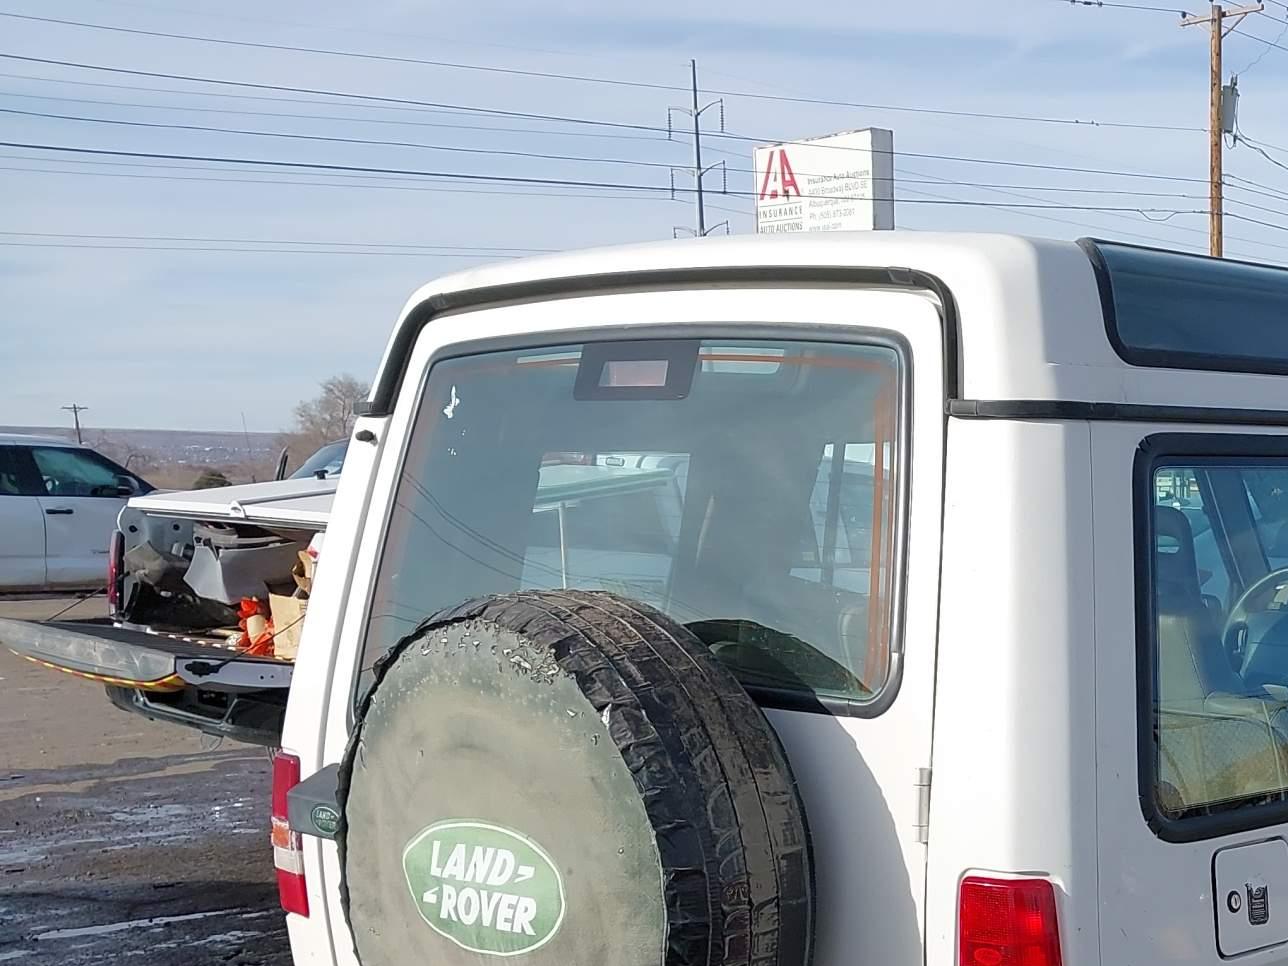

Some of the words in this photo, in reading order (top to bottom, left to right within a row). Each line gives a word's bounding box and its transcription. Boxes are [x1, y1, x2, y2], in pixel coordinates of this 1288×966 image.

[759, 206, 803, 219] INSURANCE
[775, 222, 803, 233] AUCTIONS
[430, 840, 515, 887] LAND
[439, 884, 538, 936] ROVER
